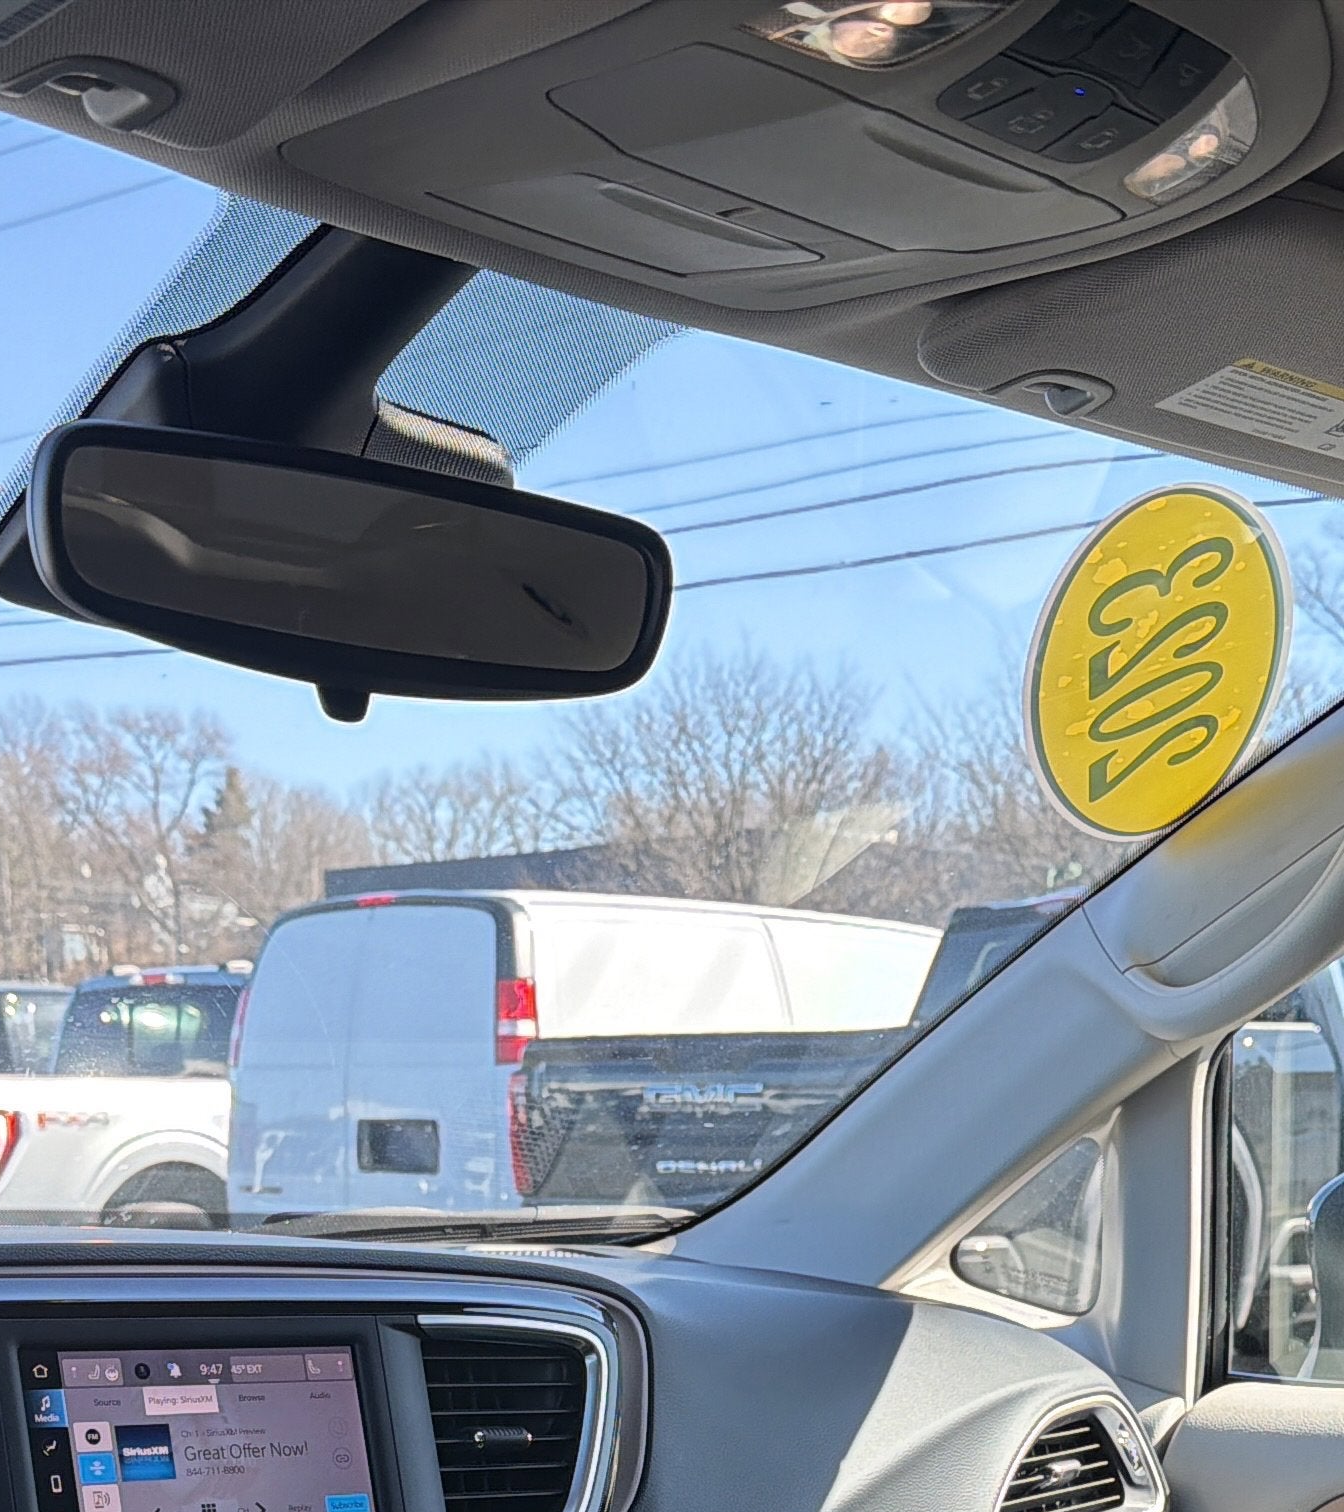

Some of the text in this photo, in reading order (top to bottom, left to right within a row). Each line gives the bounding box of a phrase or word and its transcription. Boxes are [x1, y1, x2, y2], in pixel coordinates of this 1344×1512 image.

[1260, 367, 1318, 388] WARNING
[199, 1363, 223, 1375] 9:47
[246, 1363, 263, 1374] EXT
[148, 1394, 213, 1406] Playing: SiriusXM
[238, 1394, 266, 1402] Browse
[309, 1391, 331, 1399] Audio
[93, 1398, 122, 1407] Source
[34, 1414, 60, 1423] Media
[122, 1445, 169, 1457] SiriusXM
[183, 1440, 309, 1462] Great Offer Now!
